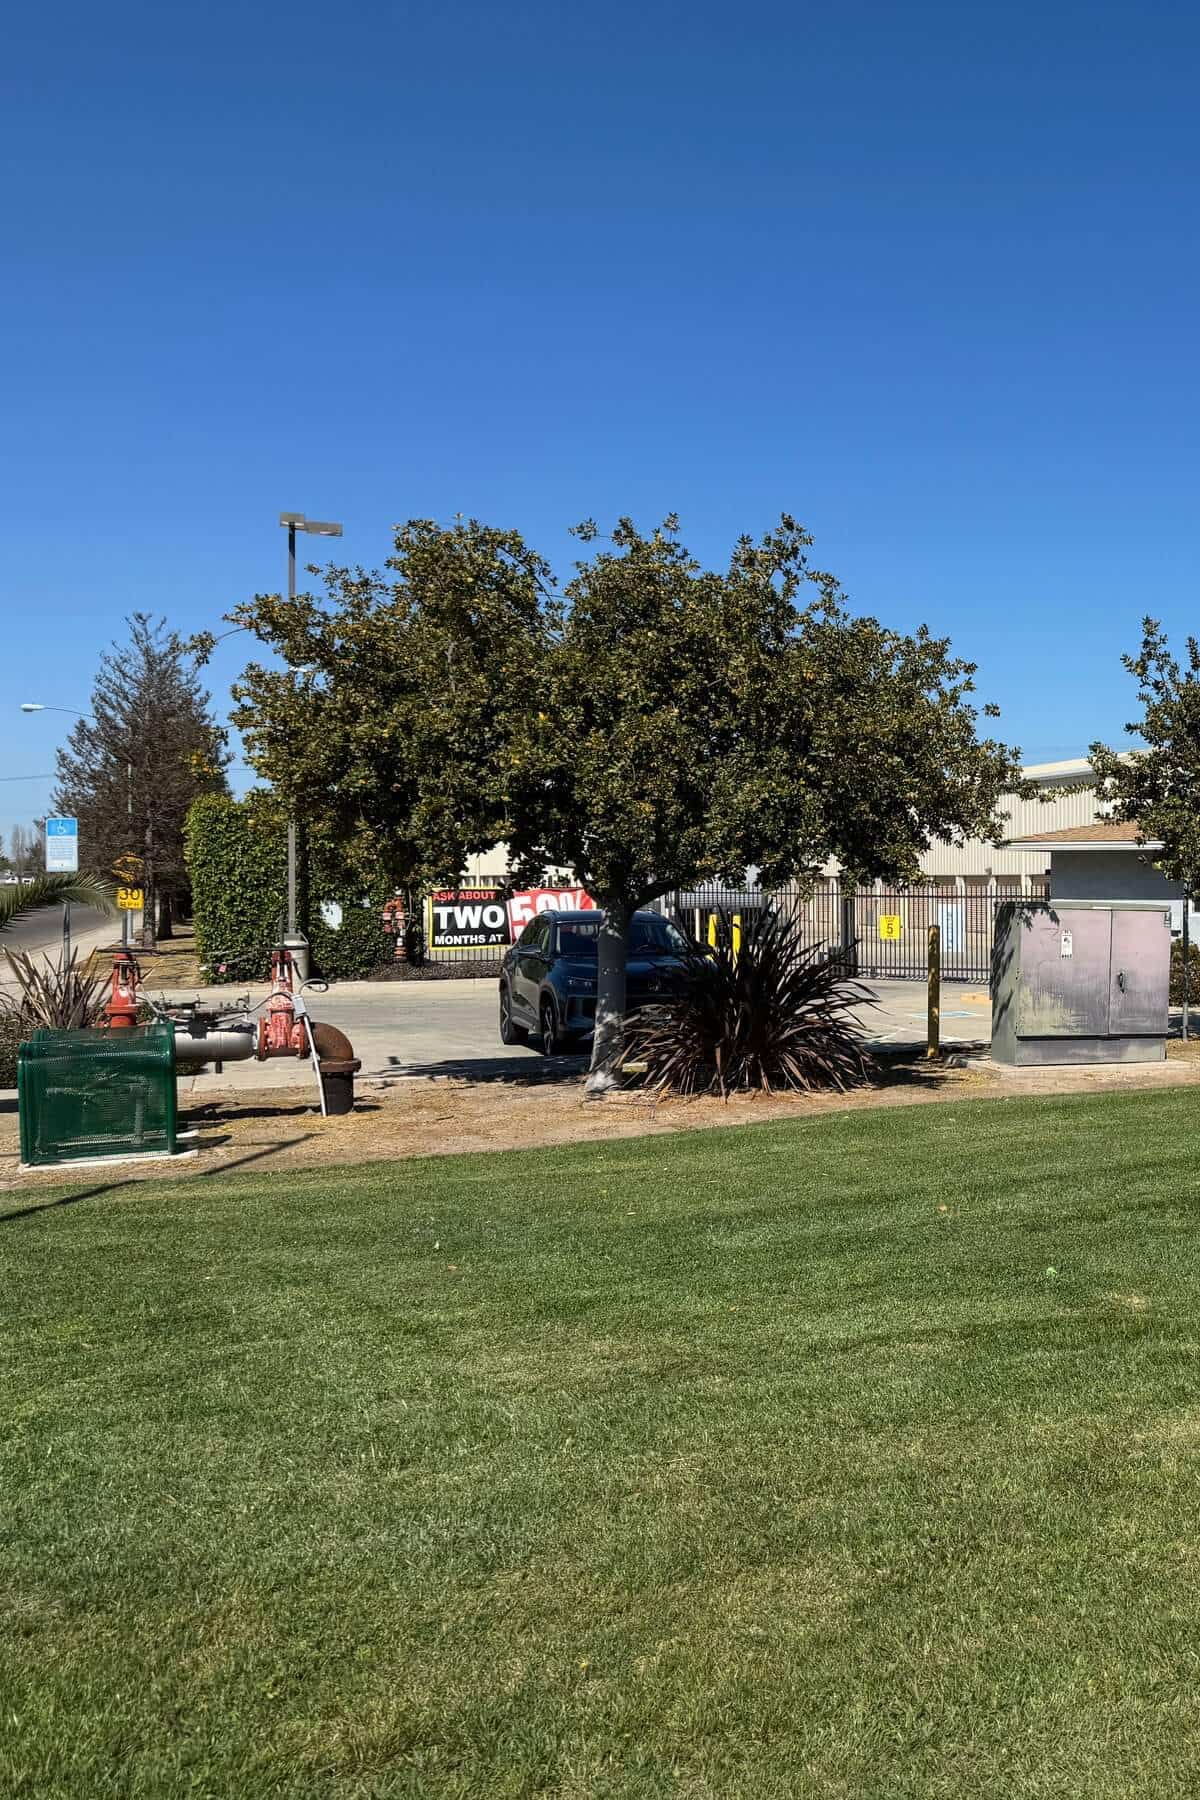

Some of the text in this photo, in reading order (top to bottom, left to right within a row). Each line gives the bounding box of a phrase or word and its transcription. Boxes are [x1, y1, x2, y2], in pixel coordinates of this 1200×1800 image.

[120, 887, 140, 900] 30
[432, 890, 496, 901] ASK ABOUT
[433, 905, 505, 929] TWO
[887, 923, 894, 934] 5
[434, 933, 504, 945] MONTHS AT
